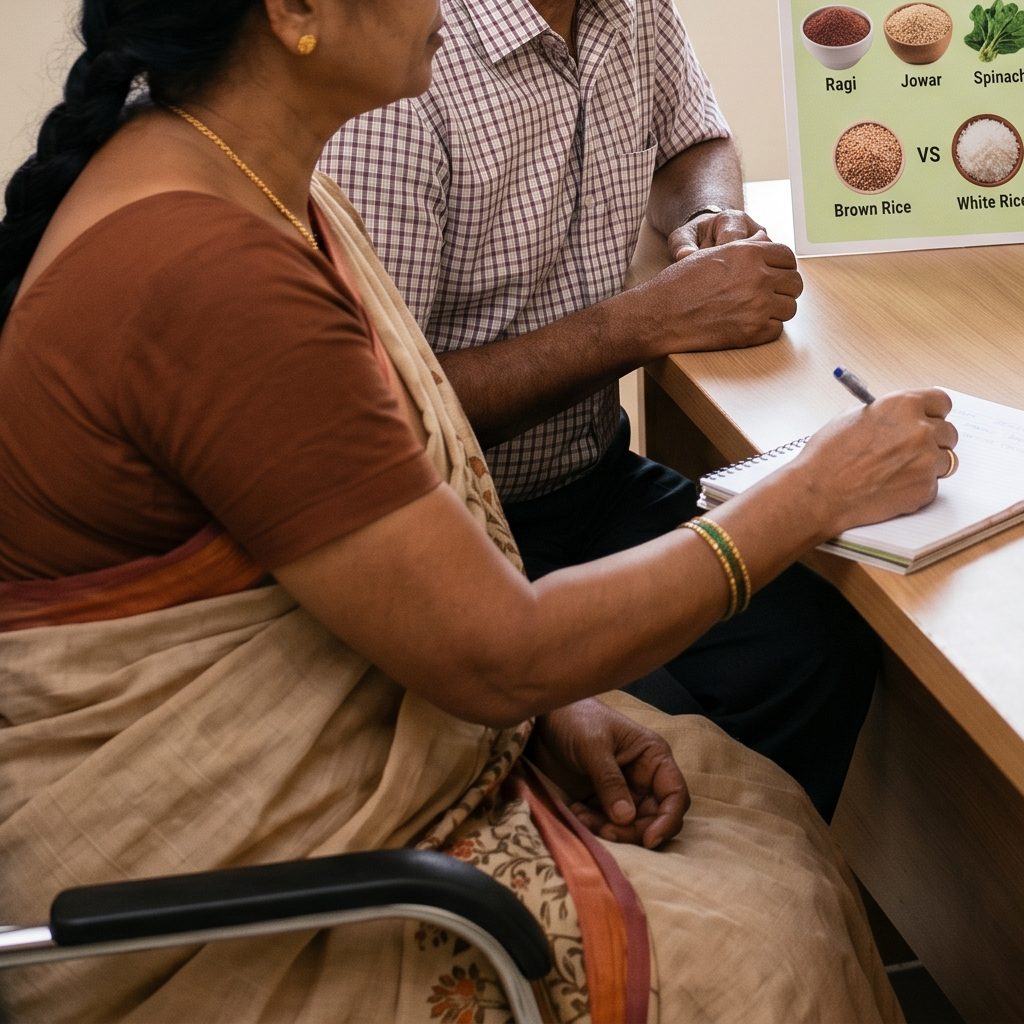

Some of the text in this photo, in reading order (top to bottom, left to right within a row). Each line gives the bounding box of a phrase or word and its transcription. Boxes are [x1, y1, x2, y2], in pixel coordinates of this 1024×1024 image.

[825, 75, 857, 94] Ragi
[900, 73, 942, 88] Jowar
[916, 145, 941, 163] VS
[834, 199, 912, 218] Brown Rice
[956, 194, 996, 211] White
